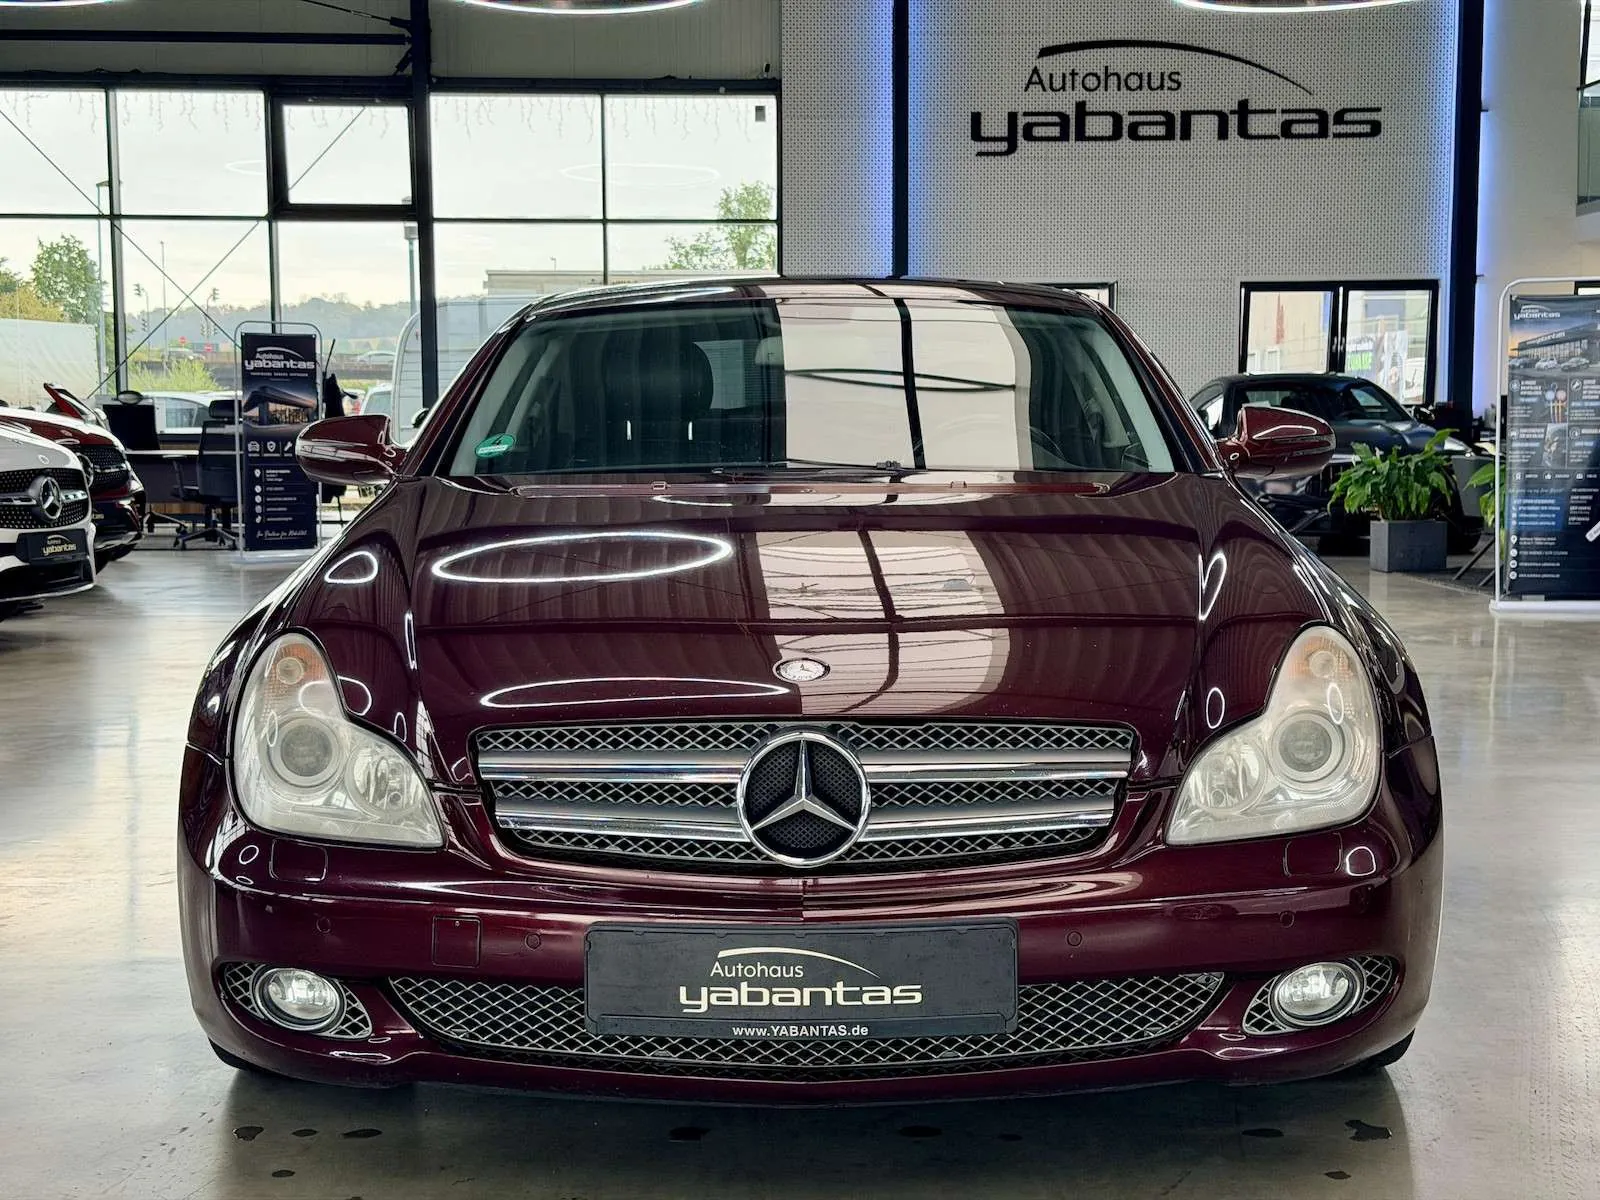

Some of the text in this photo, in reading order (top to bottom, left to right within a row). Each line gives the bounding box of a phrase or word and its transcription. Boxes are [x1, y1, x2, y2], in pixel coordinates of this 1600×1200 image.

[1023, 65, 1182, 93] Autohaus
[970, 99, 1382, 157] yabantas
[244, 358, 315, 370] yabantas
[710, 960, 804, 978] Autohaus
[679, 981, 922, 1013] yabantas
[732, 1023, 870, 1038] www.YABANTAS.de
